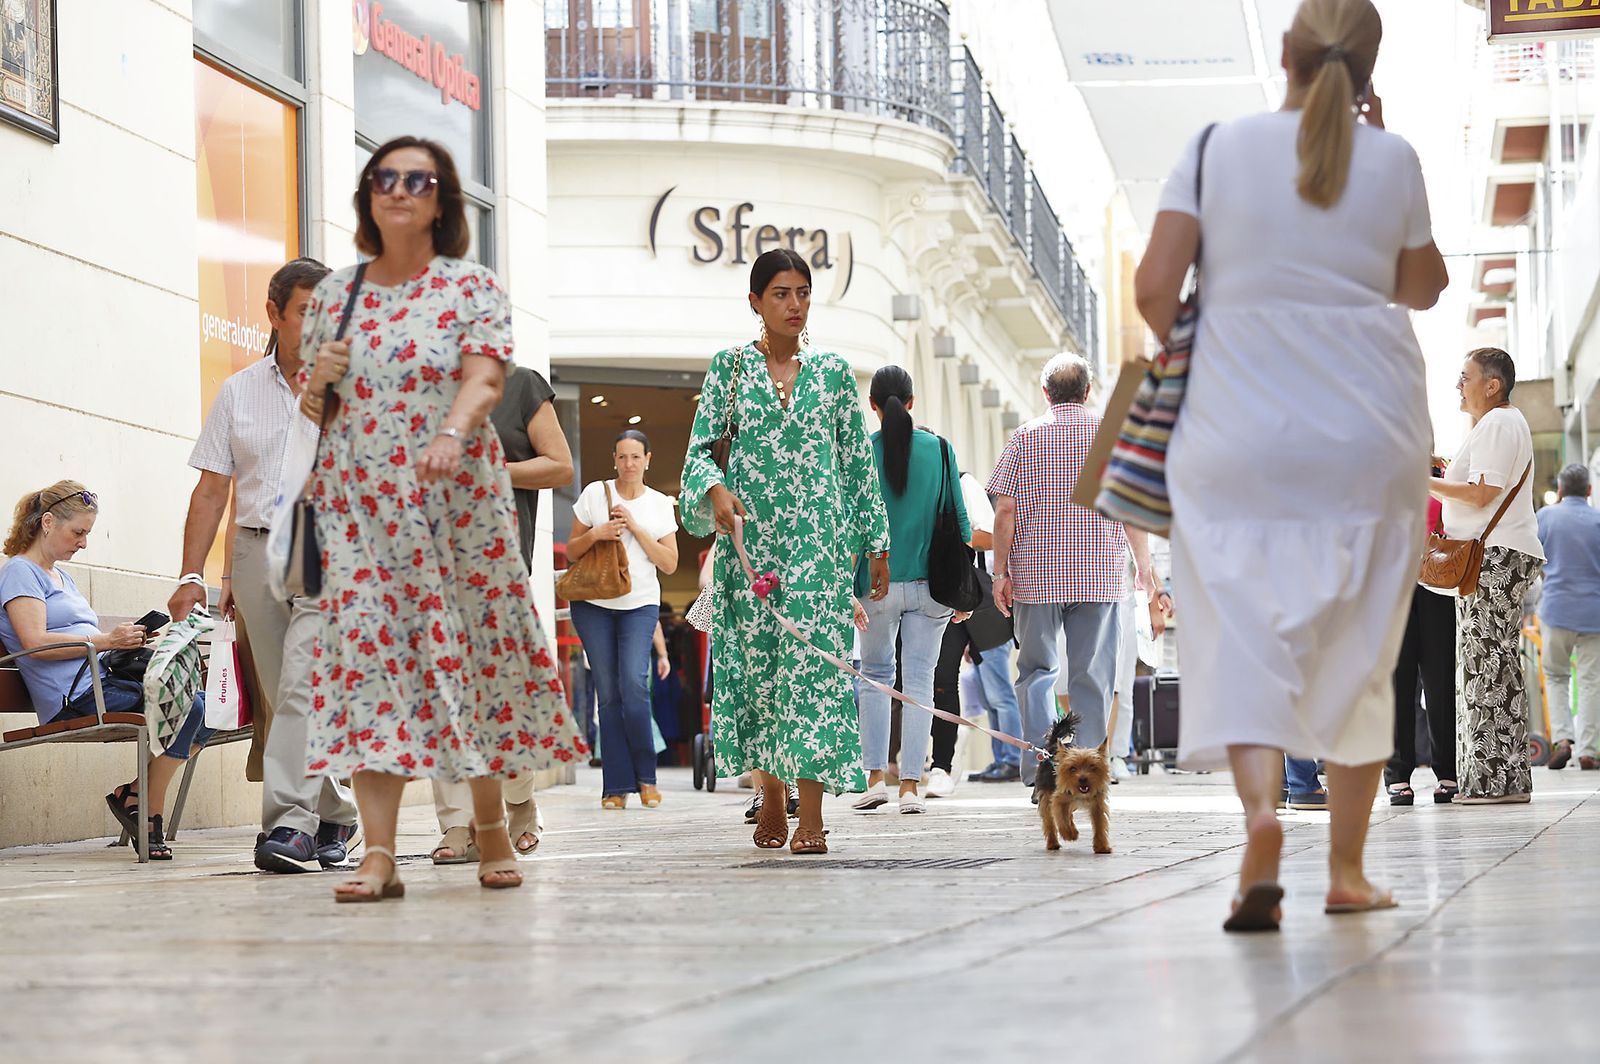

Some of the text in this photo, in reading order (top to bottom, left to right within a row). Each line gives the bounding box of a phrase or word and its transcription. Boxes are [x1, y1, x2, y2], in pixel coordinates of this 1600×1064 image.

[370, 1, 481, 111] General Optica
[219, 668, 228, 703] druni.es
